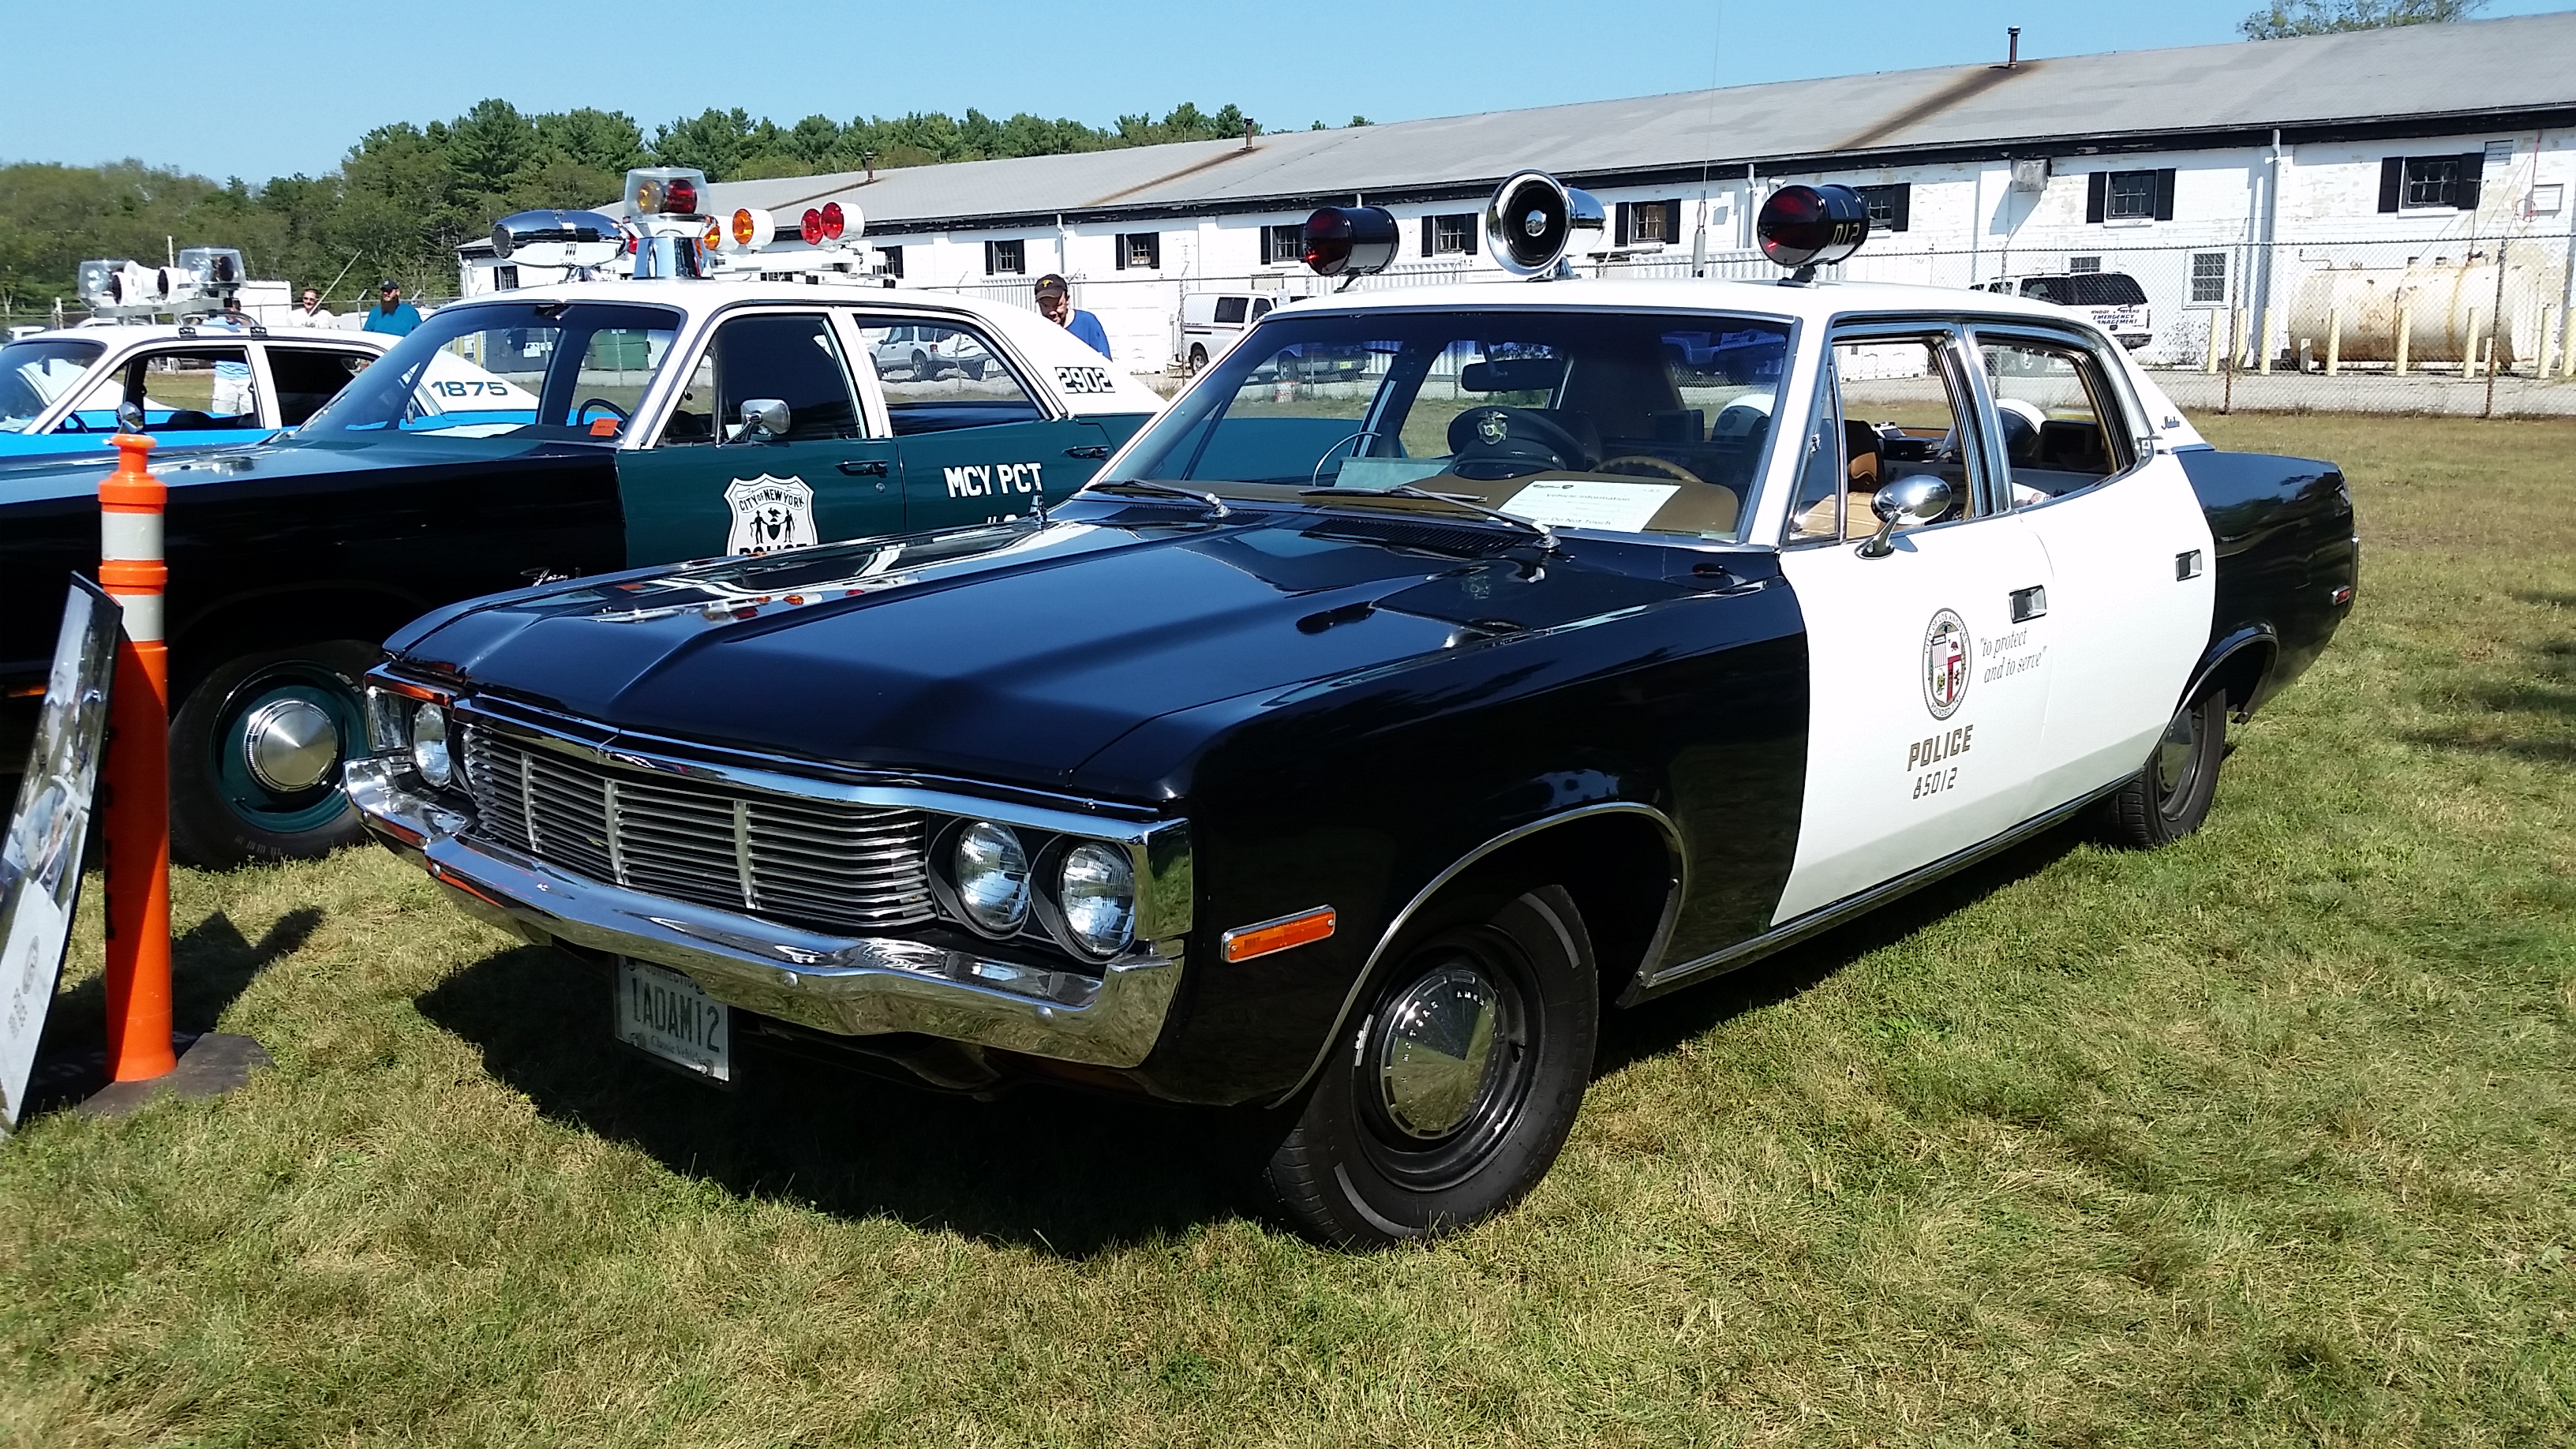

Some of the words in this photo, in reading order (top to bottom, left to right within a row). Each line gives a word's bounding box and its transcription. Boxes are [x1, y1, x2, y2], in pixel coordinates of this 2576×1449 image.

[430, 380, 508, 397] 1875
[1054, 366, 1116, 394] 2902
[943, 465, 992, 498] MCY
[996, 462, 1043, 494] PCT
[739, 495, 758, 511] CITY
[757, 492, 765, 502] OF
[762, 489, 784, 502] NEW
[784, 492, 805, 508] YORK
[1993, 627, 2027, 658] protect
[1984, 657, 2005, 683] and
[2005, 658, 2016, 676] to
[1907, 724, 1974, 772] POLICE
[1912, 766, 1958, 799] 85012
[632, 977, 720, 1054] 1ADAM12
